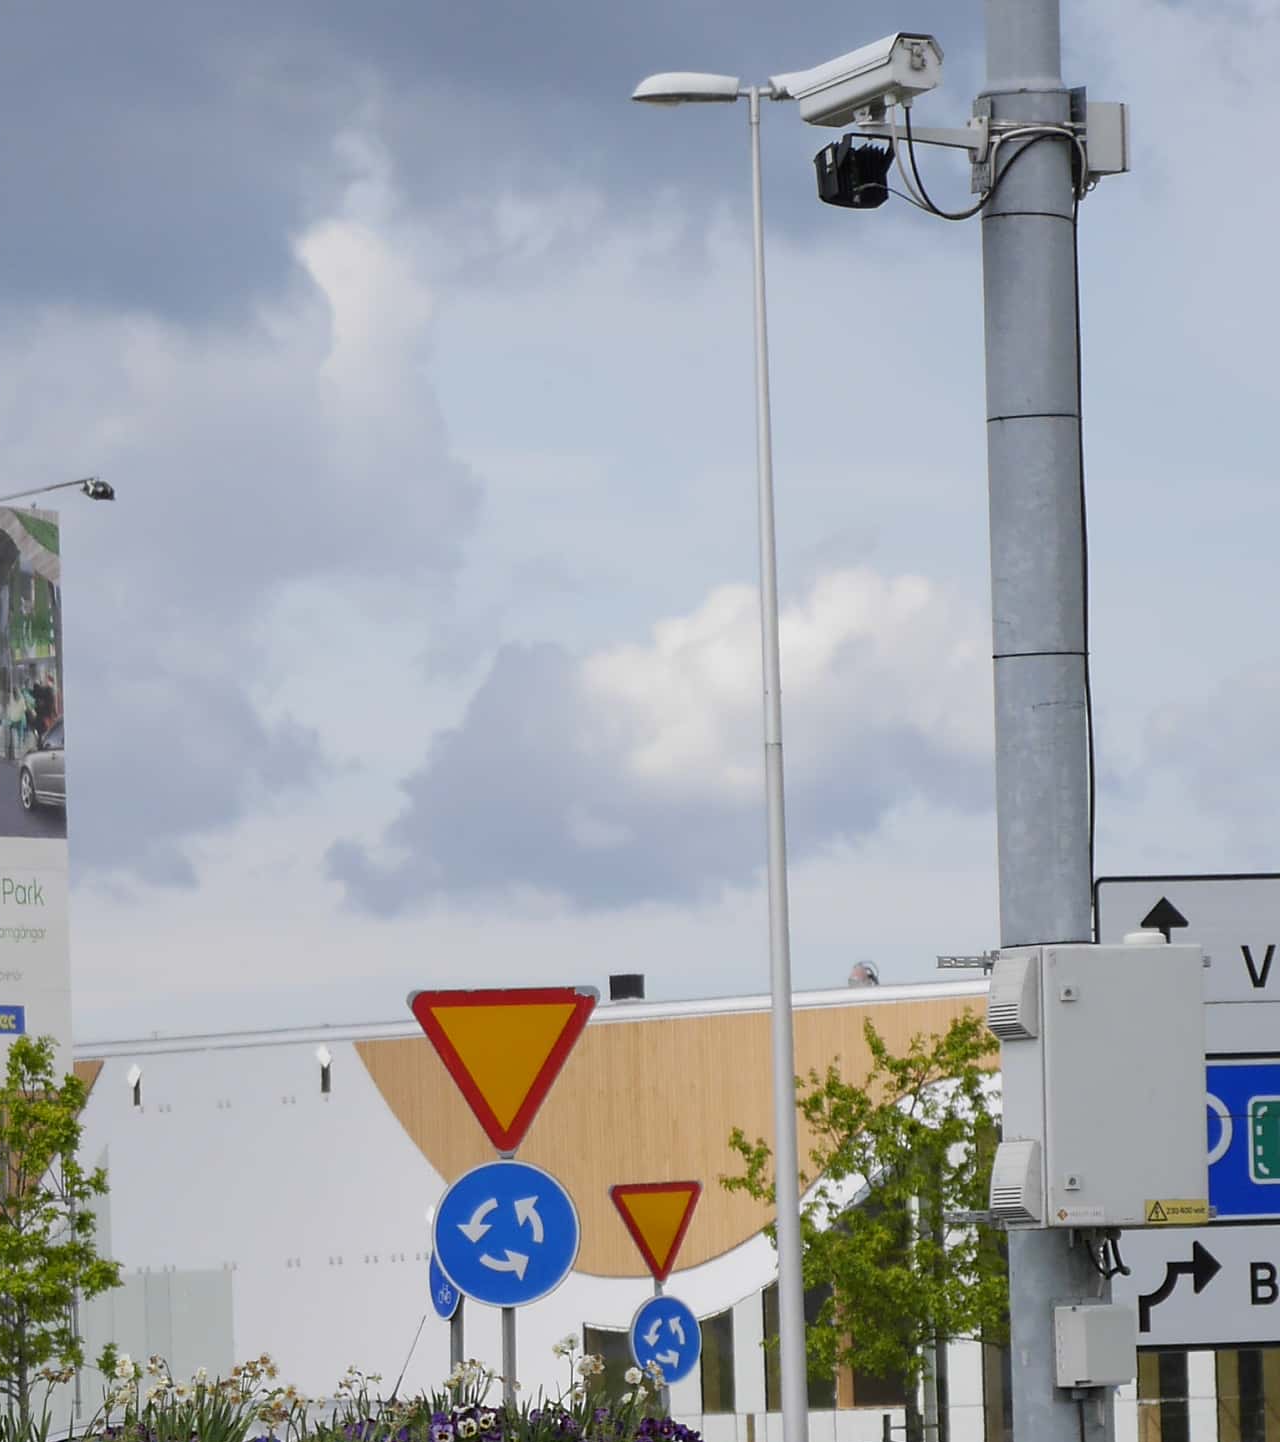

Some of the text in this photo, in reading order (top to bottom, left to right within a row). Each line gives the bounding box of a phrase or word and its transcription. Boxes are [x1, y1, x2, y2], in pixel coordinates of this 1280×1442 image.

[2, 877, 44, 906] Park
[1241, 944, 1276, 988] V
[1251, 1261, 1279, 1306] B
